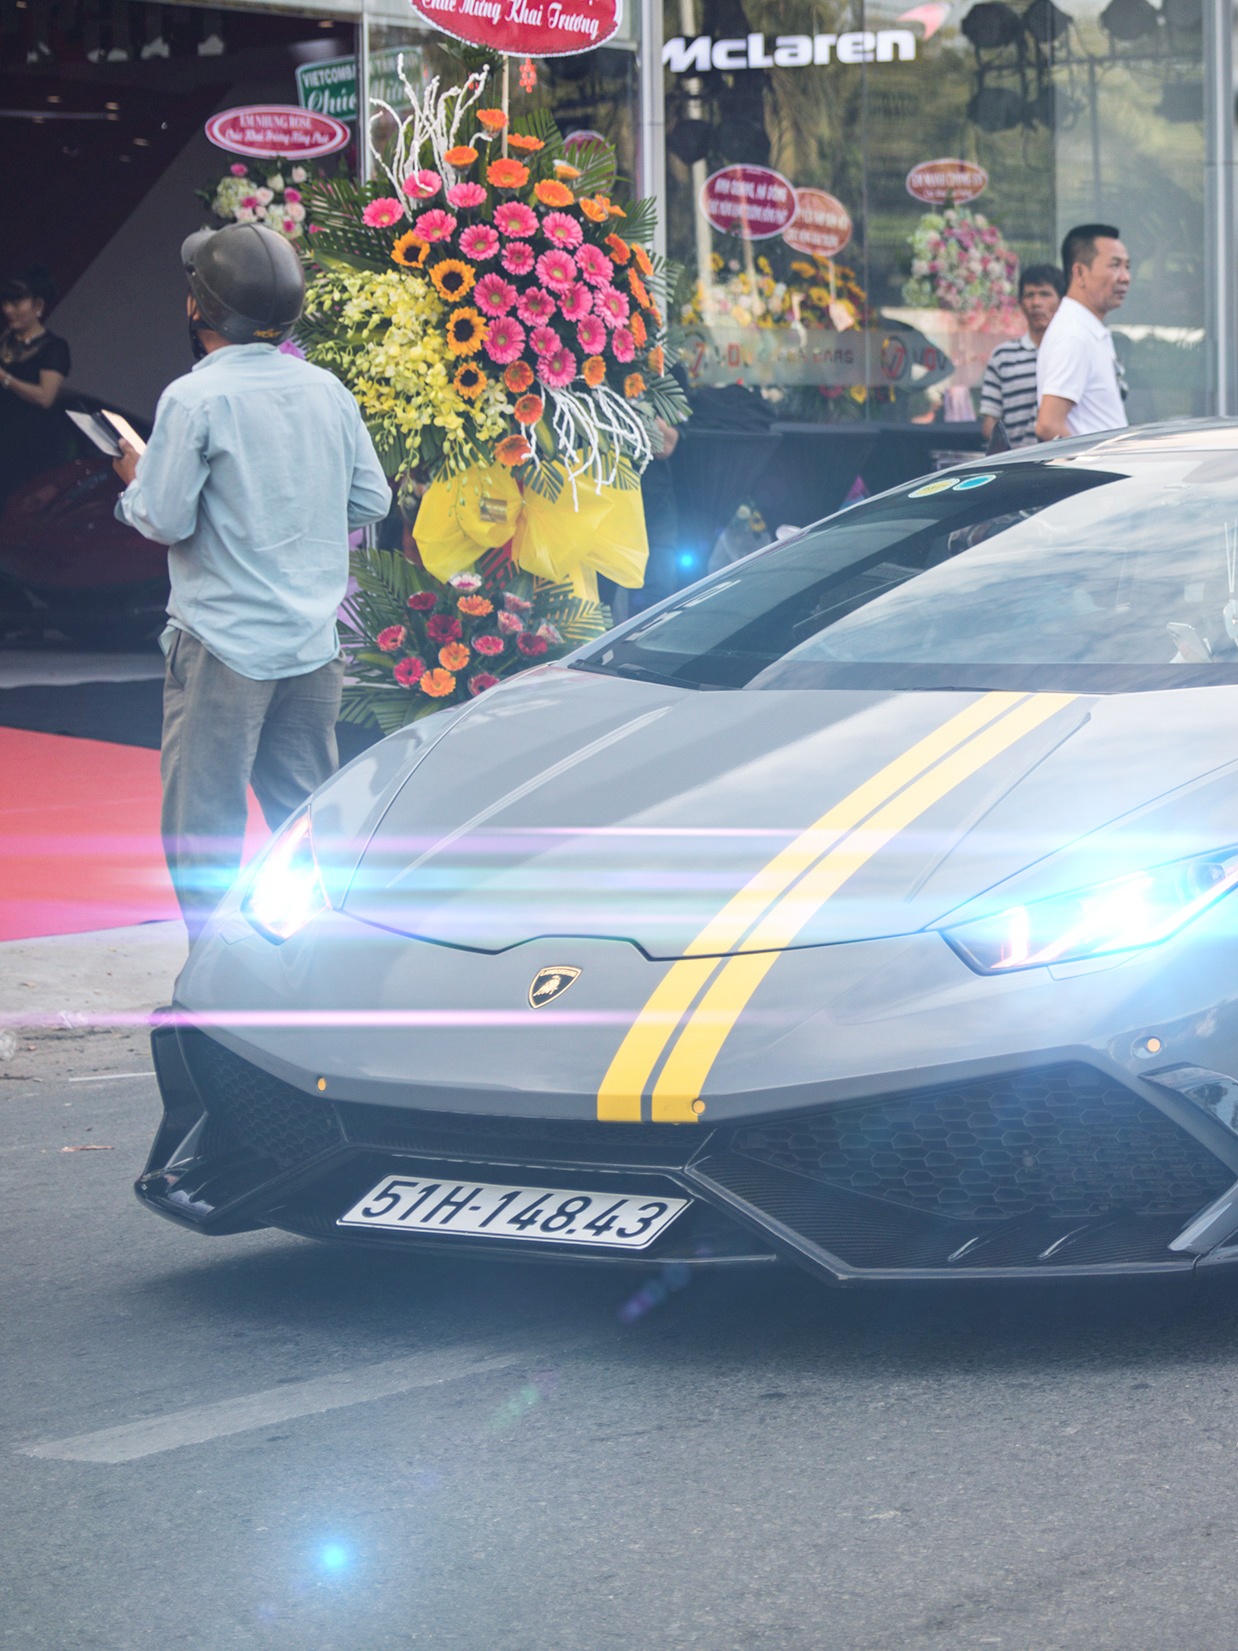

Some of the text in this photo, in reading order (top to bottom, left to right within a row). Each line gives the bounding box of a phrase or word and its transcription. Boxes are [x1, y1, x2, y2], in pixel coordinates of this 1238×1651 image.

[504, 0, 543, 27] Khai
[662, 29, 916, 73] McLaren
[361, 1180, 669, 1239] 51H-148.43
